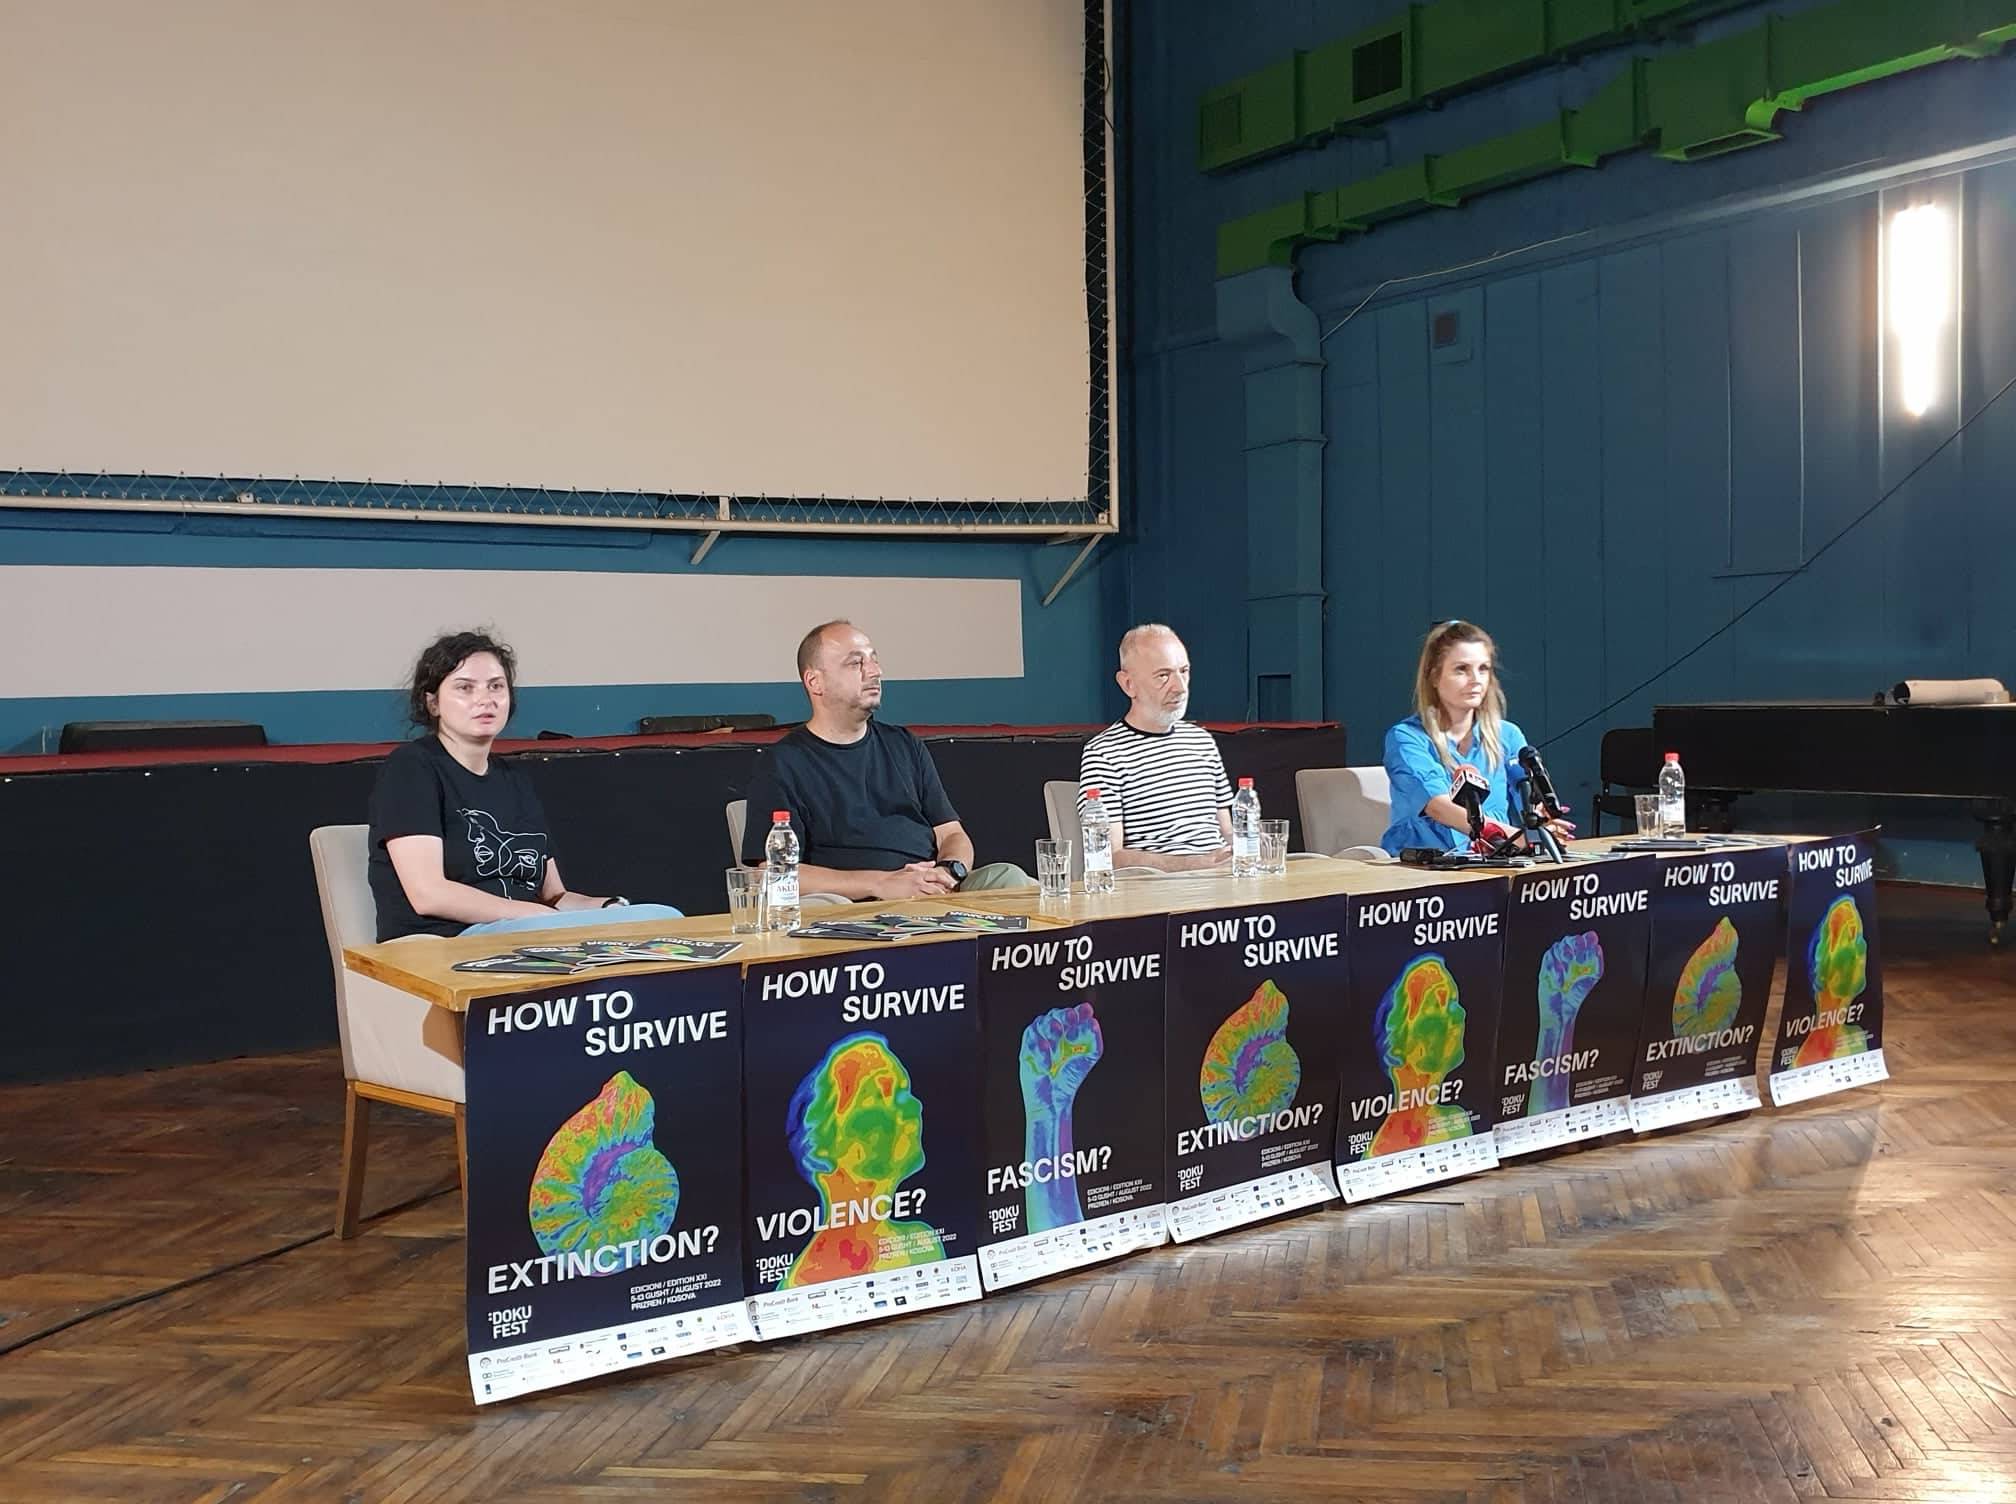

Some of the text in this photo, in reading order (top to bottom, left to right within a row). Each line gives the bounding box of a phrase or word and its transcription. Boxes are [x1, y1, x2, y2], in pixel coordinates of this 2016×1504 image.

[1664, 861, 1735, 888] HOW TO
[1798, 845, 1856, 872] HOW TO
[1835, 858, 1873, 888] SURVIVE
[1520, 873, 1599, 903] HOW TO
[1569, 889, 1648, 920] SURVIVE
[1709, 879, 1778, 906] SURVIVE
[1359, 896, 1444, 928] HOW TO
[1180, 914, 1276, 948] HOW TO
[1413, 913, 1498, 946] SURVIVE
[992, 935, 1093, 971] HOW TO
[1244, 933, 1338, 968] SURVIVE
[762, 962, 885, 1000] HOW TO
[1058, 954, 1160, 991] SURVIVE
[488, 991, 633, 1034] HOW TO
[842, 984, 965, 1023] SURVIVE
[585, 1010, 727, 1056] SURVIVE
[1785, 1003, 1864, 1038] VIOLENCE?
[1645, 1025, 1754, 1063] EXTINCTION?
[1503, 1048, 1600, 1086] FASCISM?
[1351, 1079, 1464, 1121] VIOLENCE?
[1177, 1103, 1324, 1157] EXTINCTION?
[1350, 1141, 1370, 1156] FEST
[987, 1145, 1112, 1195] FASCISM?
[1179, 1176, 1202, 1192] FEST
[756, 1189, 927, 1242] VIOLENCE?
[992, 1217, 1018, 1235] FEST
[487, 1225, 720, 1294] EXTINCTION?
[759, 1266, 790, 1284] FEST
[645, 1289, 670, 1300] GUSHT
[675, 1282, 704, 1294] AUGUST
[704, 1278, 721, 1289] 2022
[666, 1275, 695, 1287] EDITION
[631, 1298, 662, 1311] PRIZREN
[666, 1292, 697, 1304] KOSOVA
[493, 1321, 528, 1339] FEST
